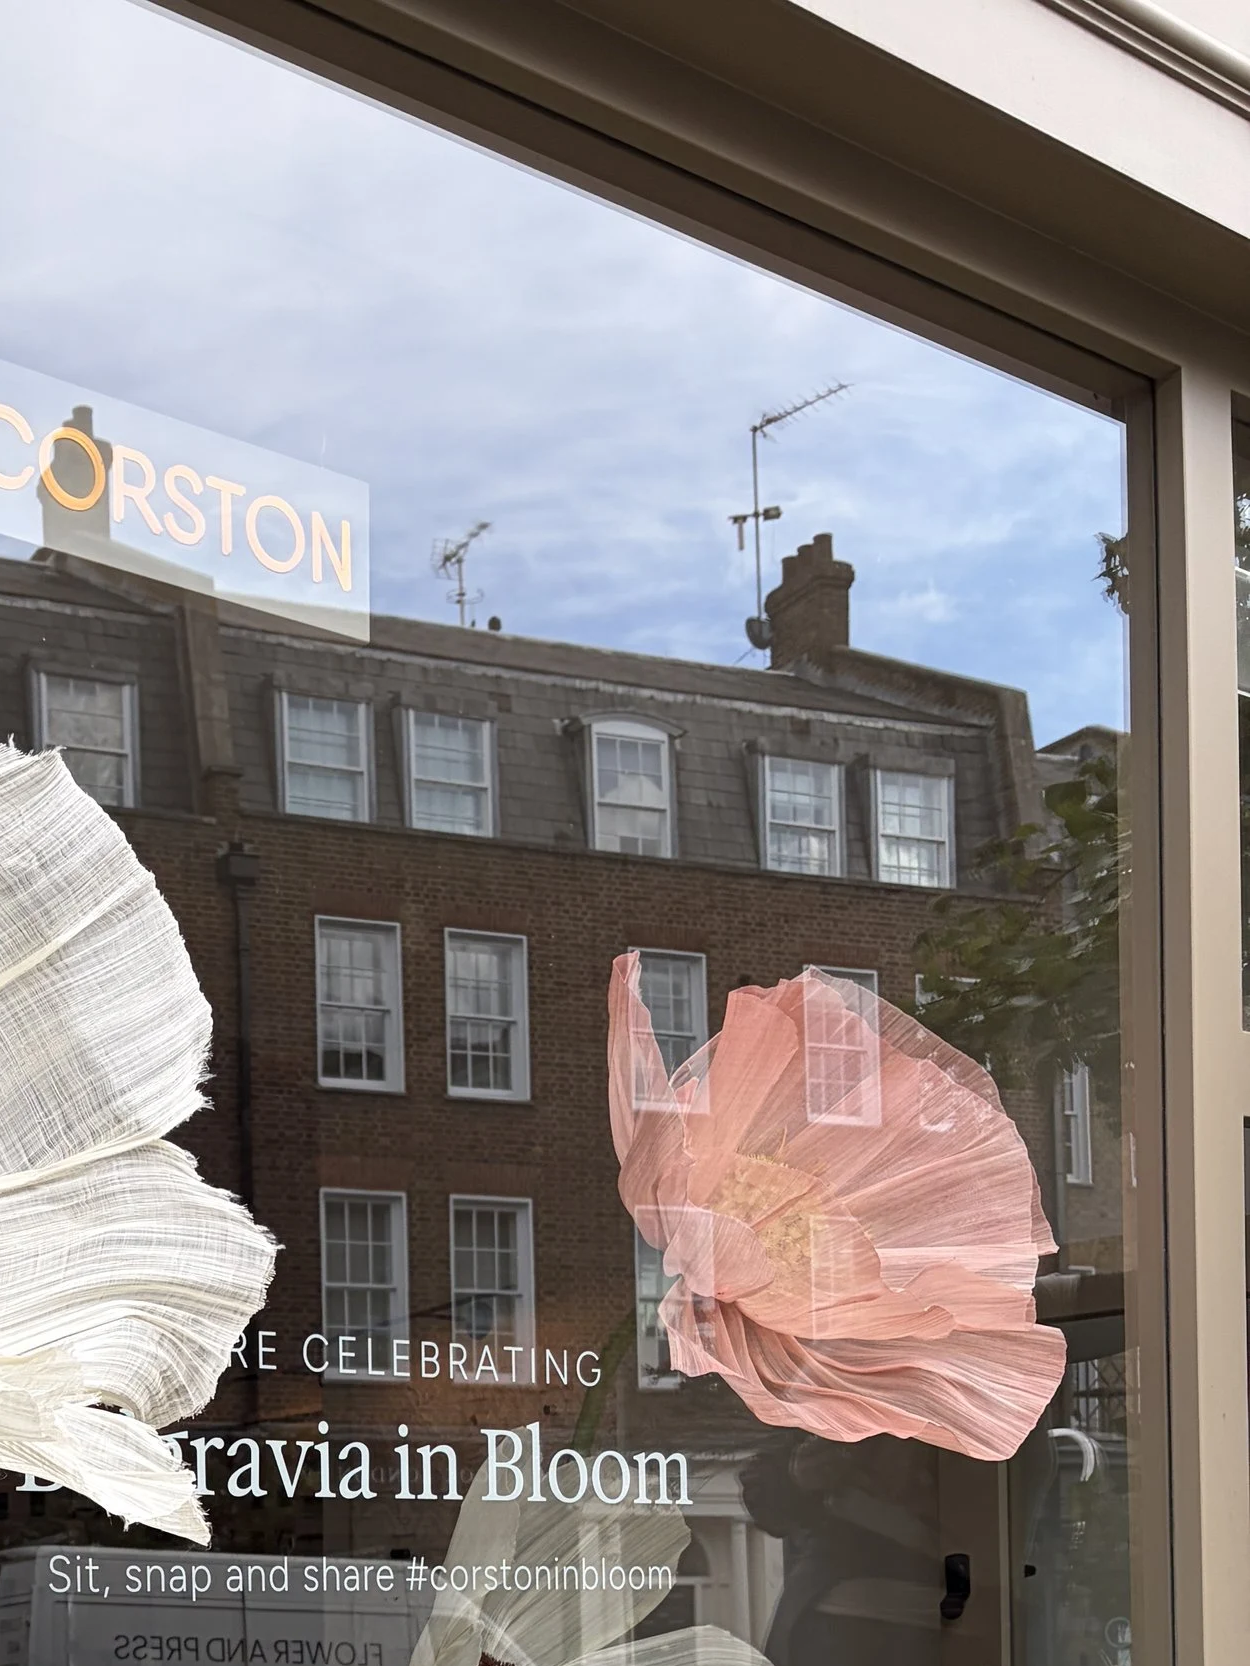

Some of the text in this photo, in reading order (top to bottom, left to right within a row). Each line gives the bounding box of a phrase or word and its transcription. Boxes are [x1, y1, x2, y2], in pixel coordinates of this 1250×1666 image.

[303, 1333, 602, 1387] CELEBRATING
[393, 1423, 463, 1500] in
[480, 1421, 694, 1506] Bloom
[49, 1555, 673, 1602] Sit, snap and share #corstoninbloom
